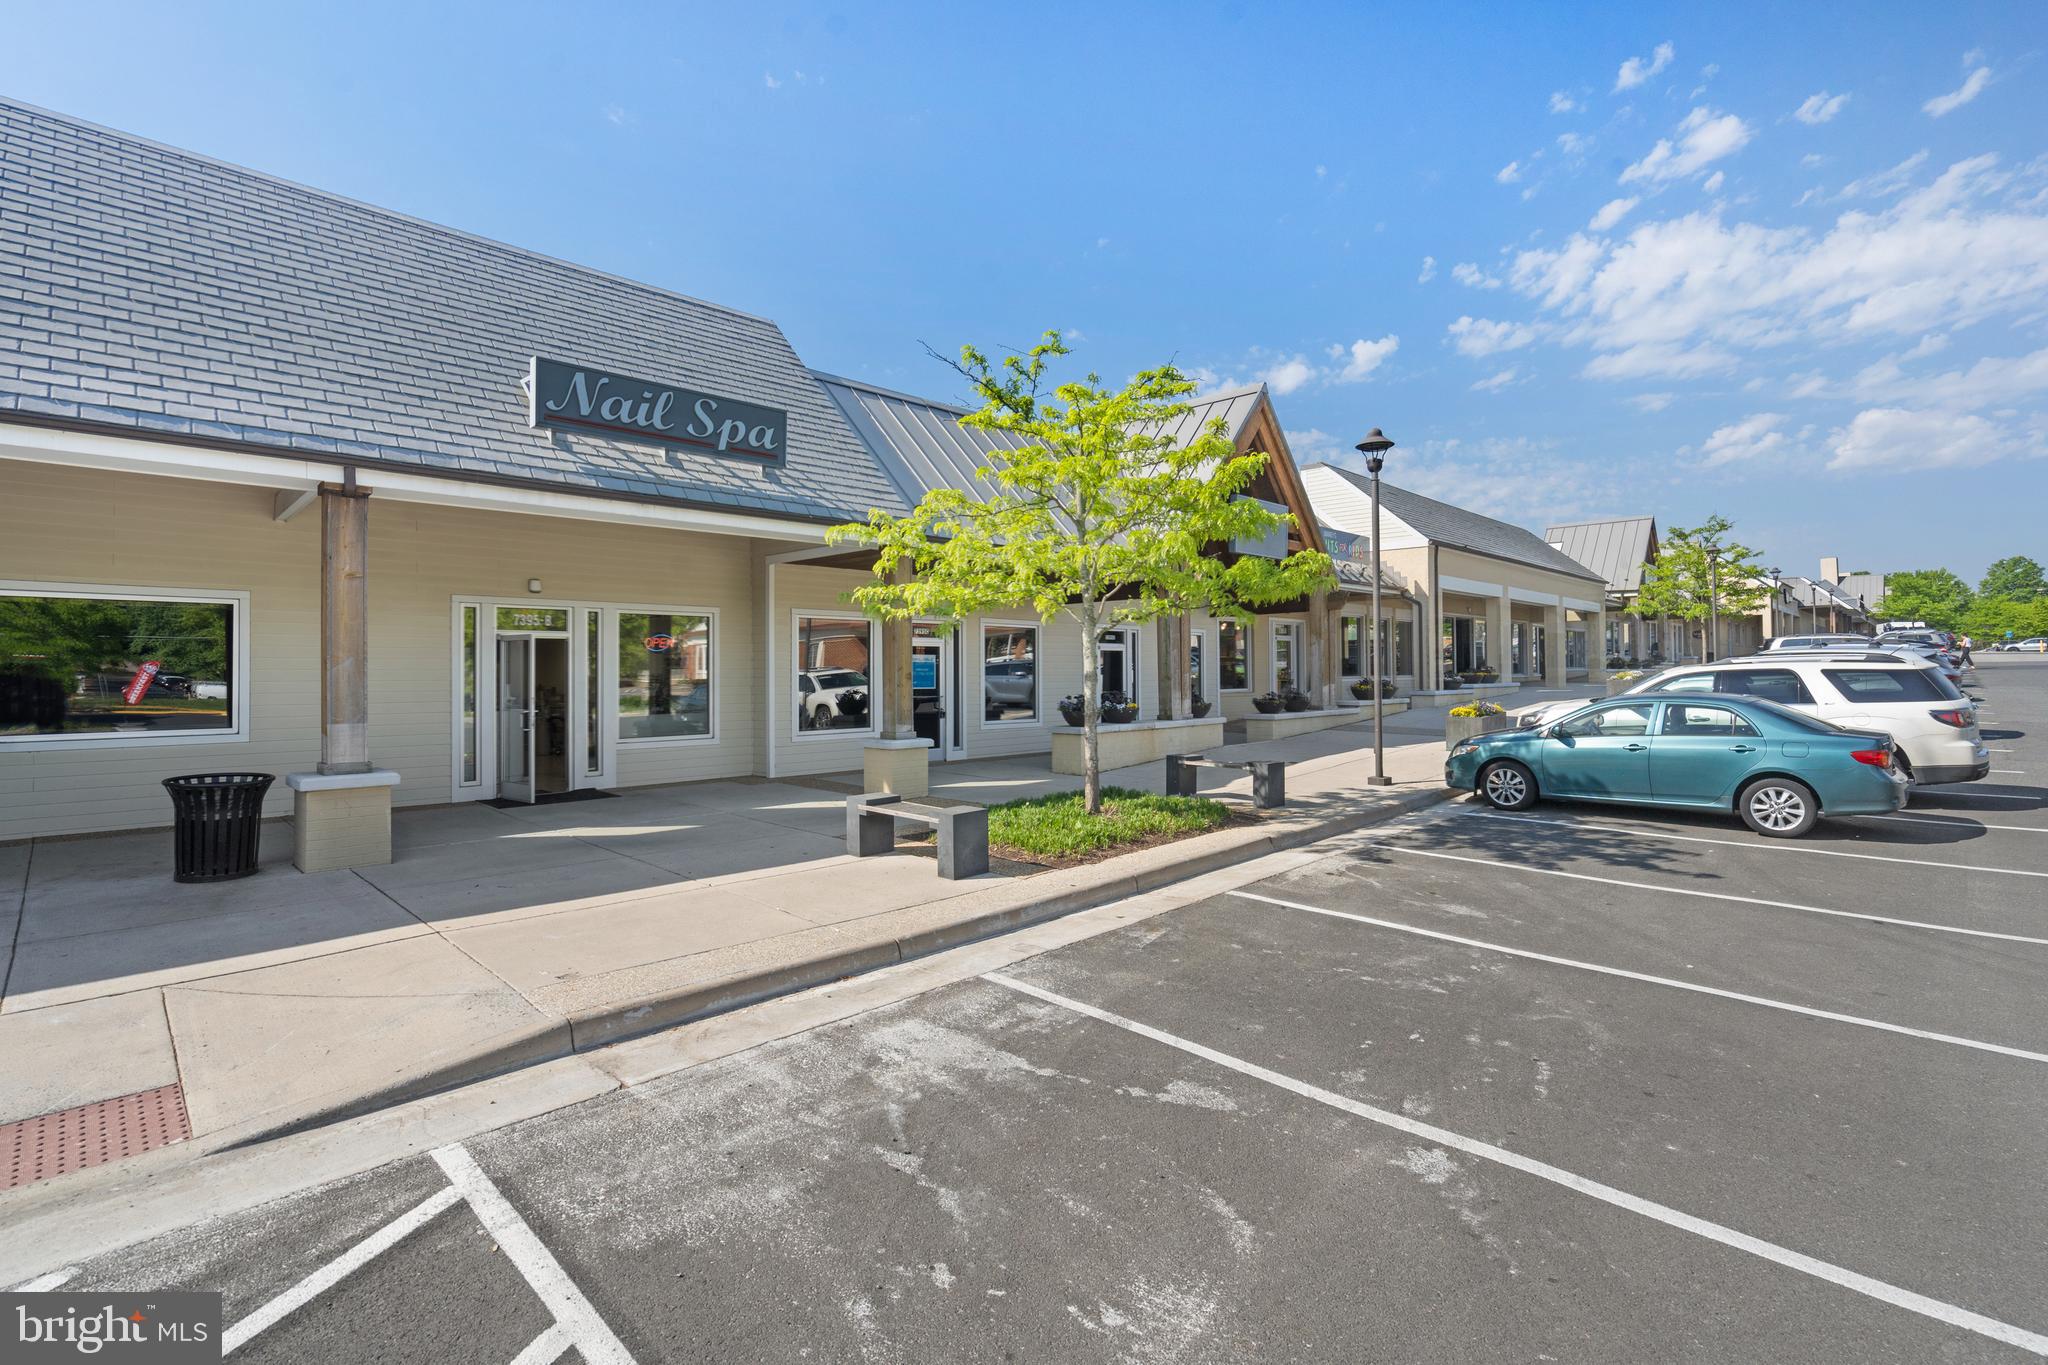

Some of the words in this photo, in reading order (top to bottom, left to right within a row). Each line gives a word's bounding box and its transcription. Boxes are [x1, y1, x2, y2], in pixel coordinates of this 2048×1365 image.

[546, 372, 674, 430] Nail
[687, 399, 778, 450] Spa
[645, 637, 674, 649] OPEN
